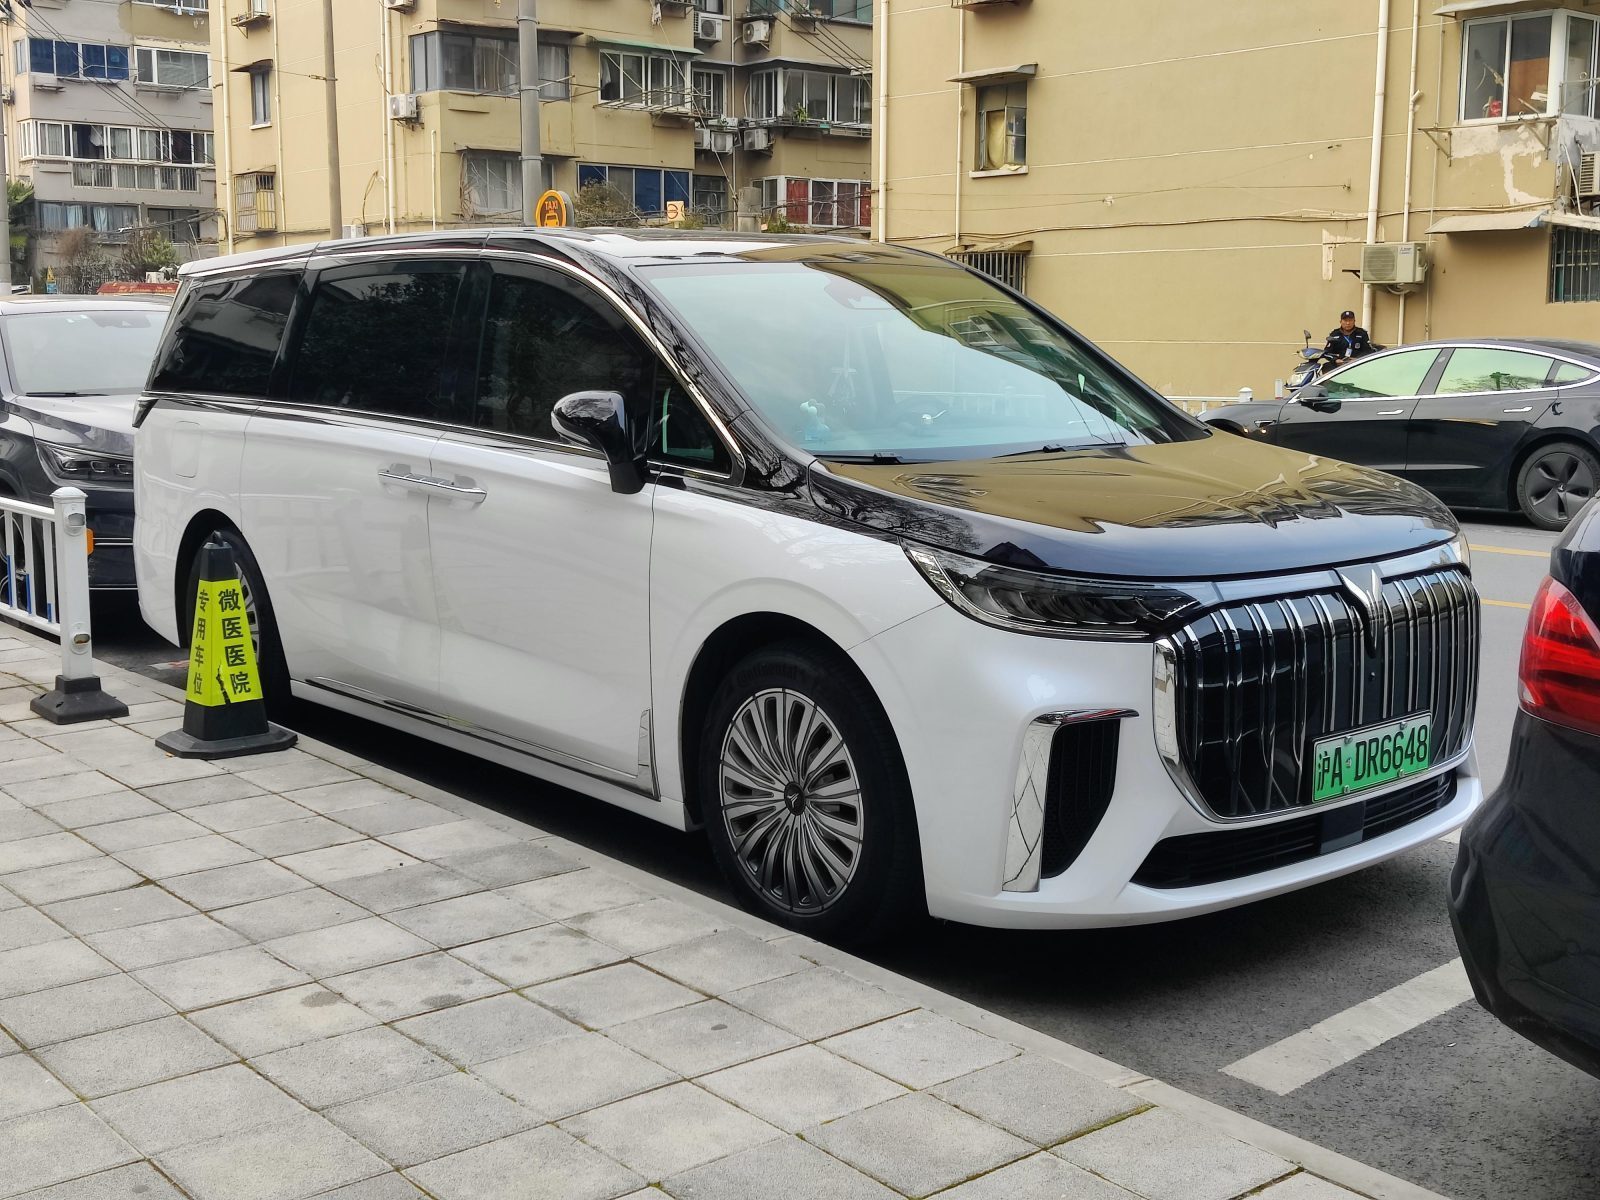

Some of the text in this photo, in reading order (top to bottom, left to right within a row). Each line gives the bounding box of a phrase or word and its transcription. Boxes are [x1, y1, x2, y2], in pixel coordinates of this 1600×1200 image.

[545, 201, 559, 210] TAXI
[194, 590, 210, 695] 专用车位
[218, 588, 251, 694] 微医医院
